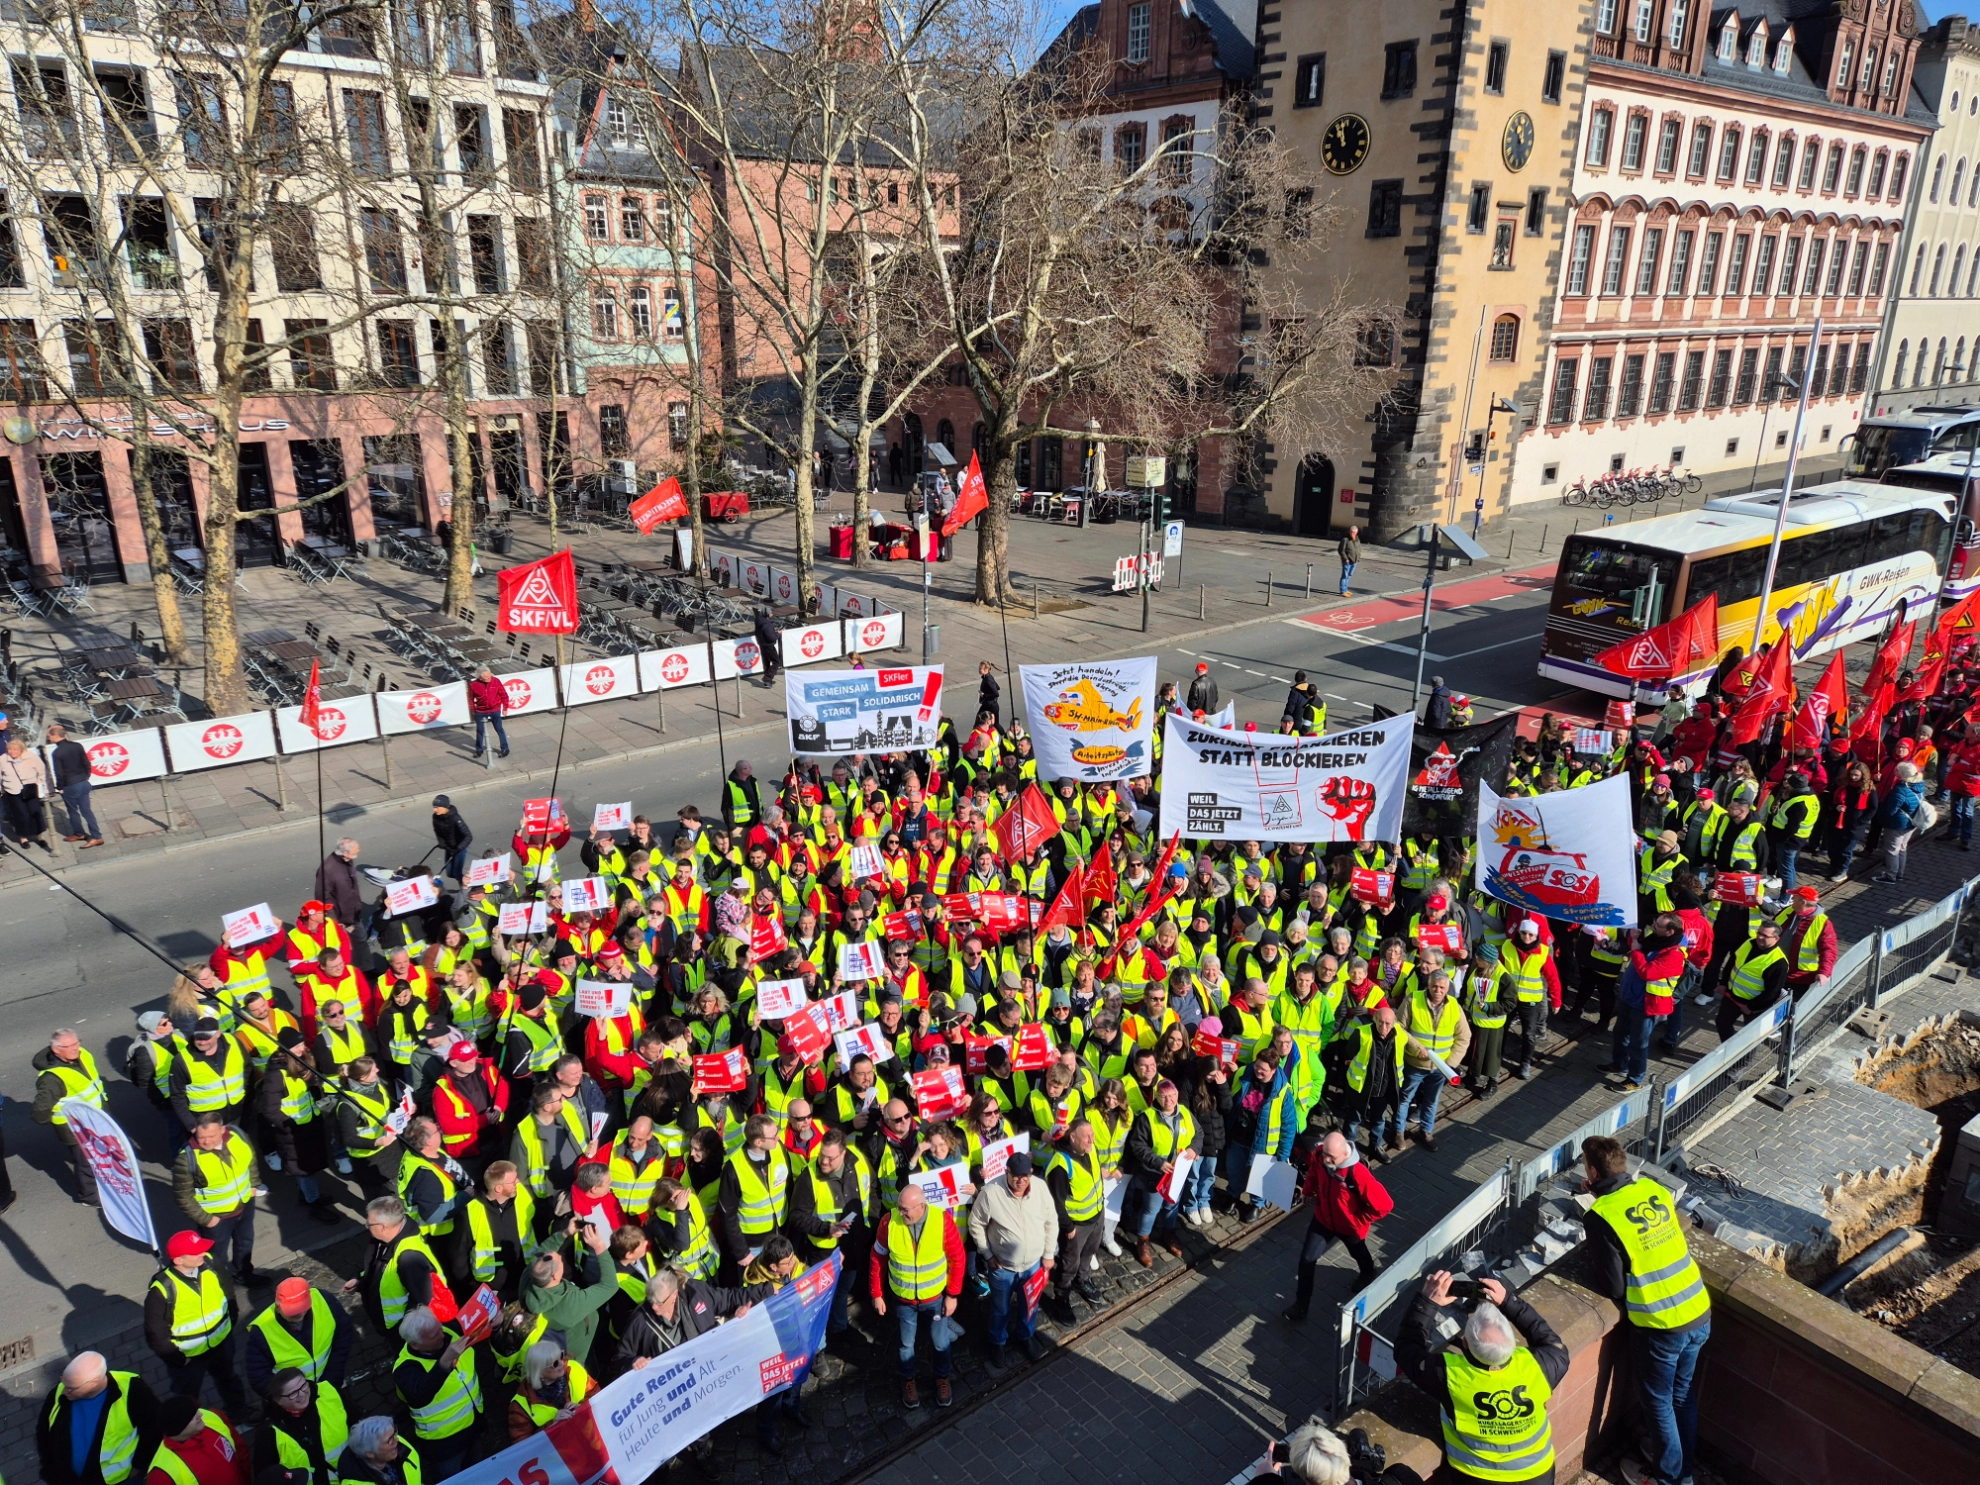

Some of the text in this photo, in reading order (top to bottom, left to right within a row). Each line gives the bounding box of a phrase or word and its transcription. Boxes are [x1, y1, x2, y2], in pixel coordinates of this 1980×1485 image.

[1860, 567, 1910, 590] GWK-Reisen
[1572, 598, 1606, 615] GWK
[509, 609, 573, 628] SKF/VL
[1052, 666, 1074, 680] Jetzt
[812, 683, 869, 697] GEMEINSAM
[864, 693, 920, 707] SOLIDARISCH
[822, 706, 852, 718] STARK
[798, 733, 820, 741] SKF
[1199, 750, 1368, 769] STATT BLOCKIEREN
[1189, 795, 1214, 804] WEIL
[1189, 809, 1239, 820] DAS JETZT
[1188, 820, 1222, 831] ZÄHLT.
[1625, 1195, 1671, 1234] SOS
[761, 1355, 782, 1370] WEIL
[763, 1357, 805, 1381] DAS JETZT
[610, 1357, 696, 1427] Gute Rente:
[618, 1427, 635, 1445] für
[637, 1398, 666, 1430] Jung
[667, 1373, 697, 1402] und
[700, 1359, 718, 1380] Alt
[1473, 1385, 1534, 1420] SOS
[625, 1365, 744, 1462] Heute und Morgen.
